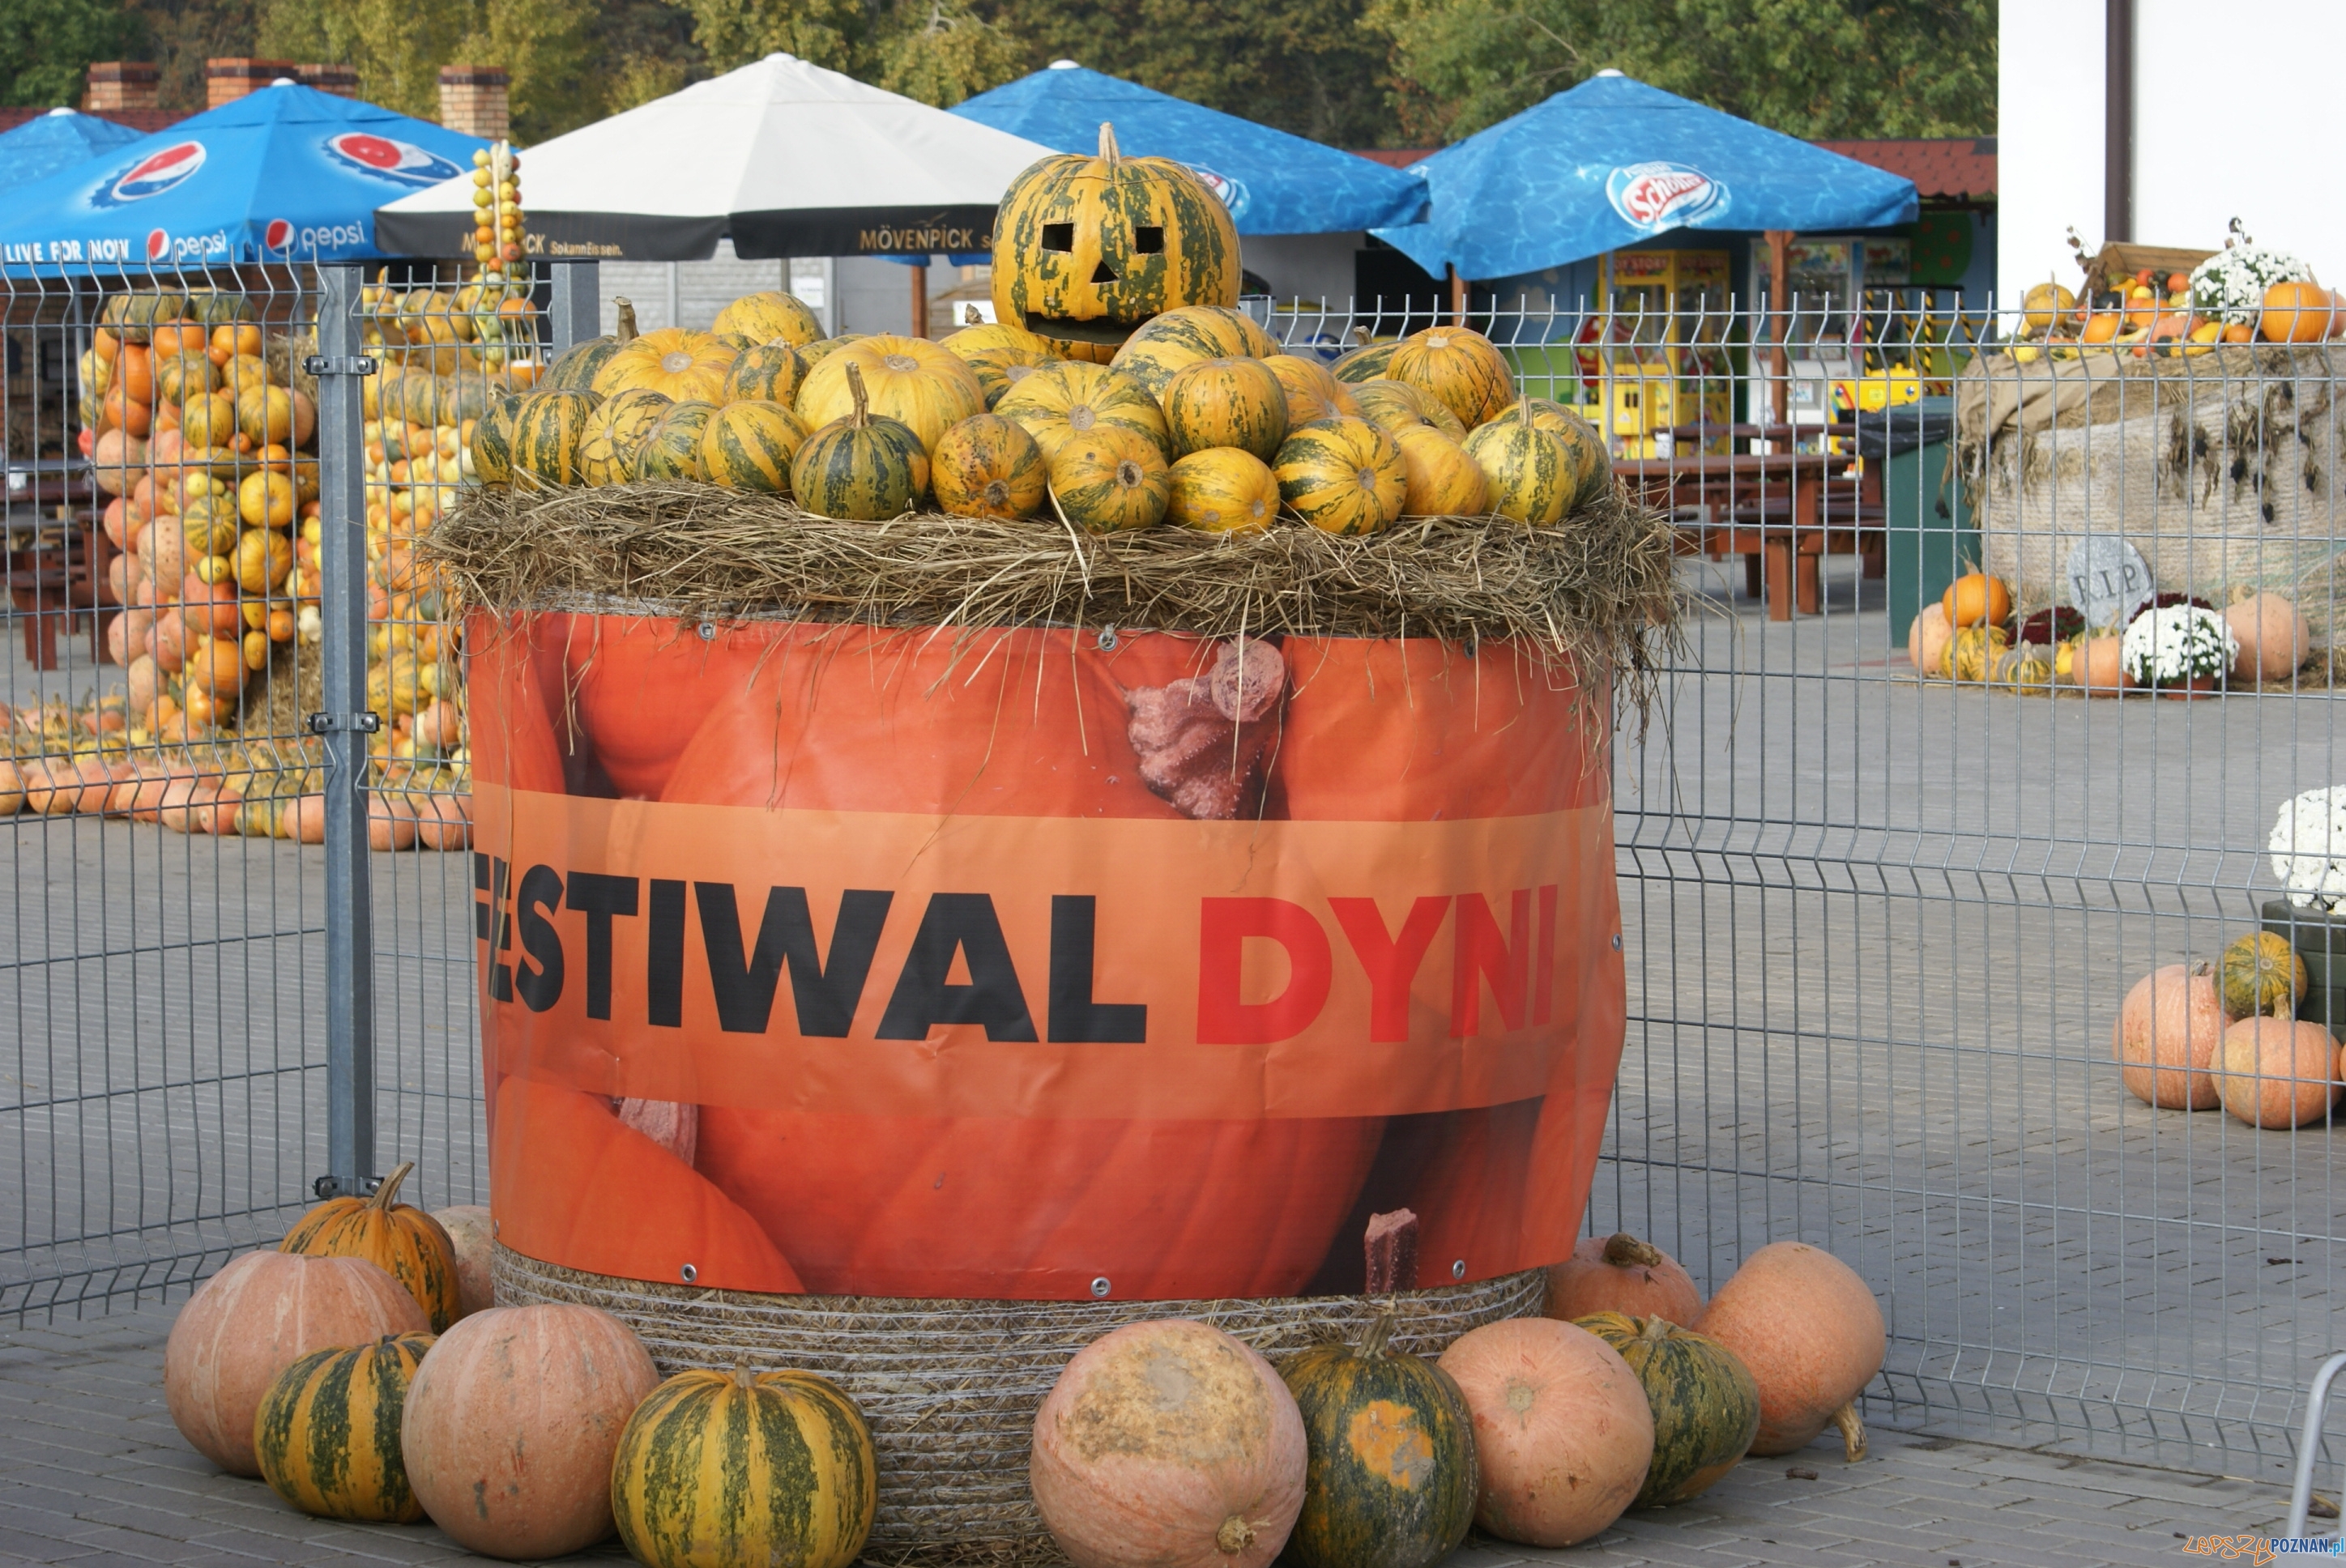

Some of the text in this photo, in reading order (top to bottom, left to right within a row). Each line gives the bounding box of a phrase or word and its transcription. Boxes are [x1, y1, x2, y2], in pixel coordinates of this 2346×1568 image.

[5, 238, 130, 262] LIVE FOR NOW
[174, 228, 227, 263] pepsi
[301, 220, 366, 253] pepsi
[1196, 884, 1558, 1045] DYNI
